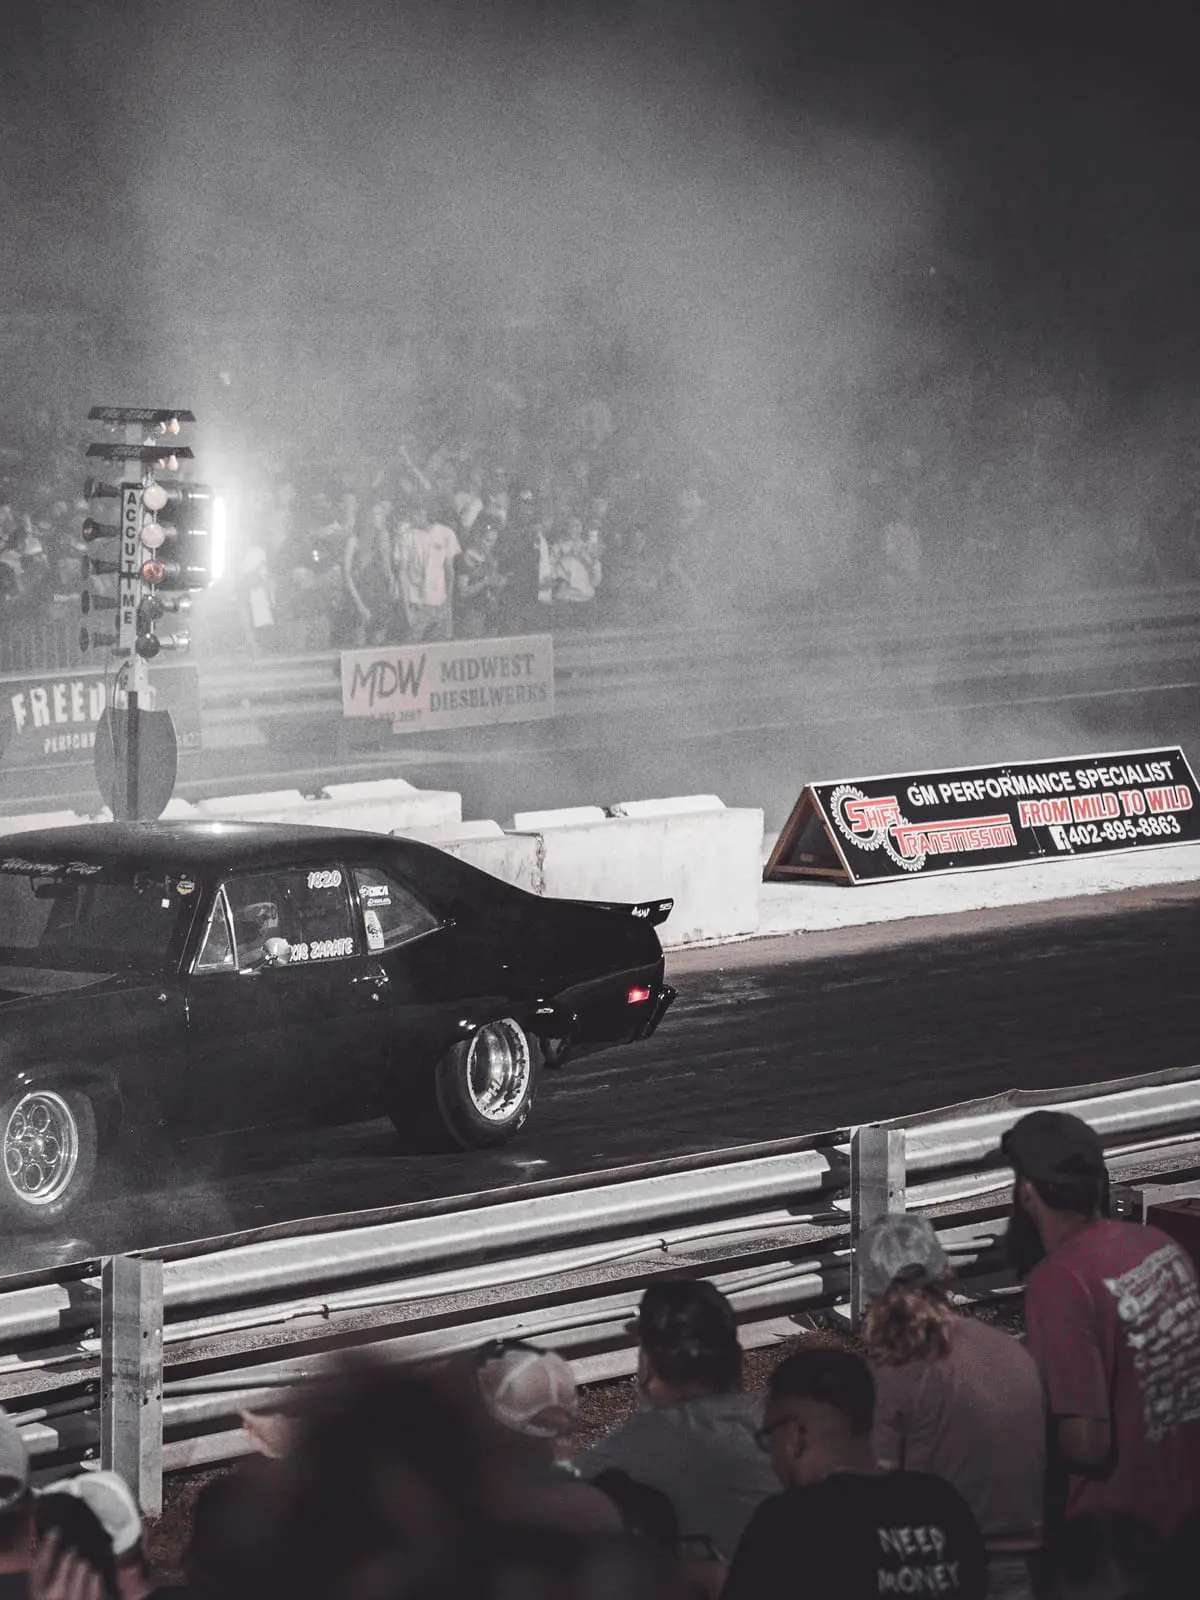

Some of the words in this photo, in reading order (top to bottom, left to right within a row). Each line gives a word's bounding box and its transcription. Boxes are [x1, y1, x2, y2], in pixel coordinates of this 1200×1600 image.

[350, 653, 426, 706] MDW
[439, 653, 535, 683] MIDWEST
[428, 681, 548, 712] DIESELWERKS
[907, 783, 940, 807] GM
[940, 771, 1071, 803] PERFORMANCE
[1075, 761, 1175, 789] SPECIALIST
[845, 795, 902, 834] SHIFT
[1017, 798, 1072, 829] FROM
[1071, 792, 1120, 822] MILD
[1119, 789, 1146, 816] TO
[1145, 784, 1194, 811] WILD
[1067, 814, 1182, 847] 402-895-8863
[307, 869, 342, 889] 1820
[310, 937, 353, 960] ZARATE
[877, 1525, 946, 1561] NEED
[877, 1562, 962, 1597] MONEY
